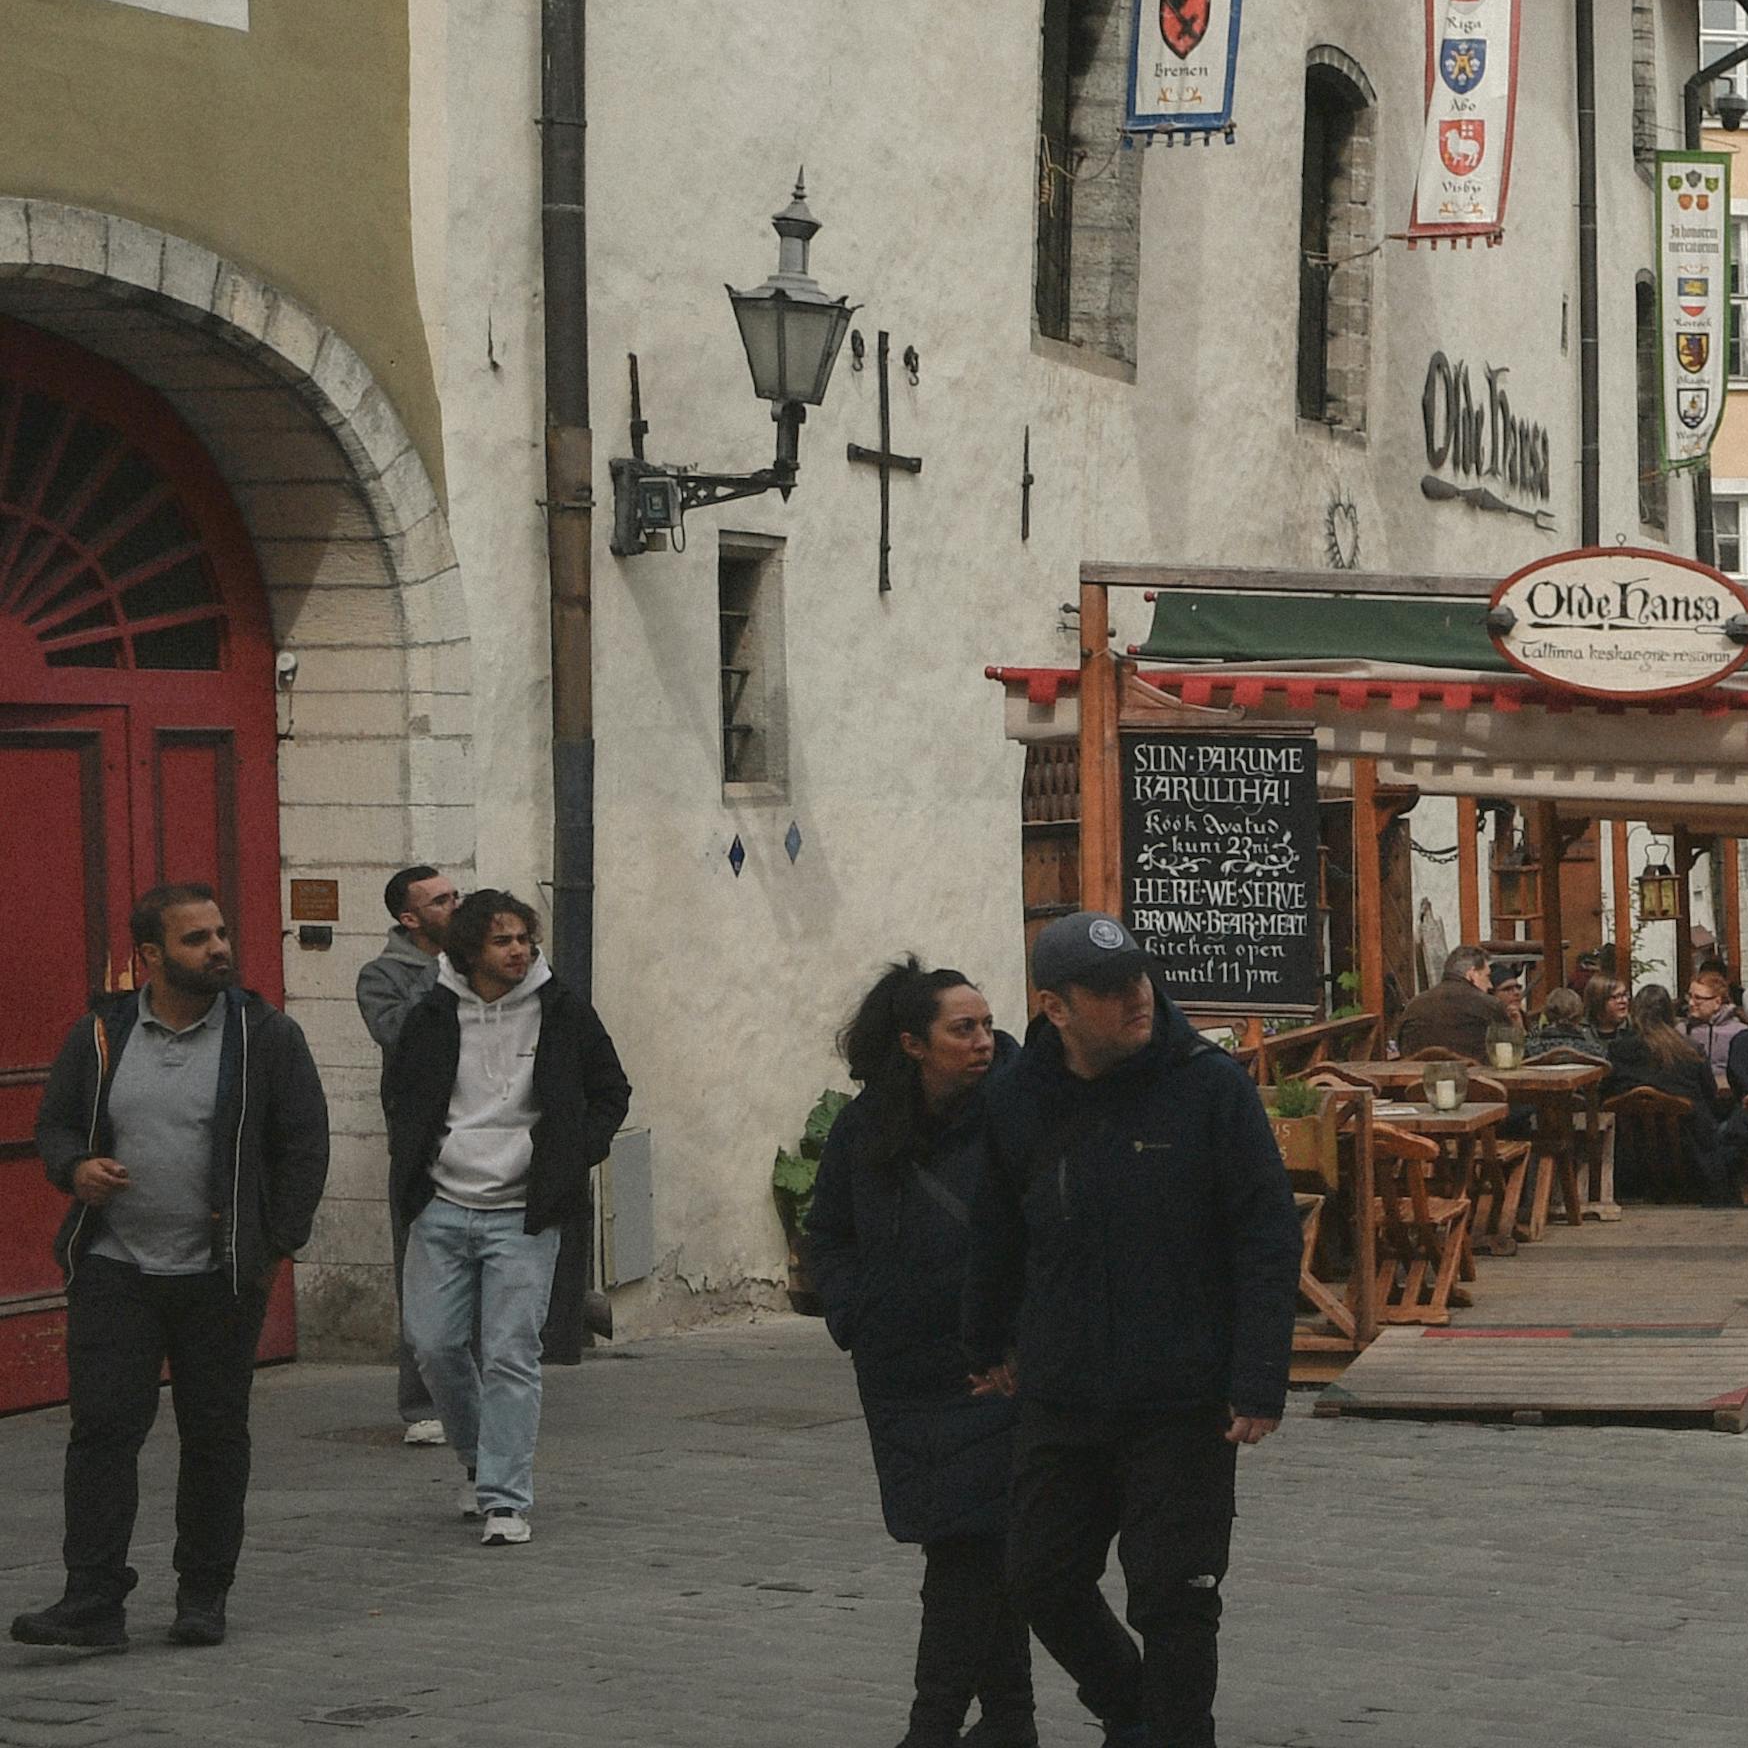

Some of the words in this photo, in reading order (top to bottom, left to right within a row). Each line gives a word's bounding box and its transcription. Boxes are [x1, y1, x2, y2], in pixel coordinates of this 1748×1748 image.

[1446, 16, 1482, 34] Riga
[1154, 63, 1209, 78] Bremen
[1422, 350, 1486, 481] Olde
[1526, 580, 1611, 621] Olde
[1520, 639, 1584, 660] Tallinna
[1132, 774, 1291, 816] KARULIHA!
[1202, 813, 1280, 836] Avatud
[1171, 835, 1222, 854] kuni
[1235, 943, 1286, 966] open
[1164, 956, 1215, 984] until
[1218, 961, 1241, 984] 11
[1246, 968, 1284, 994] pm
